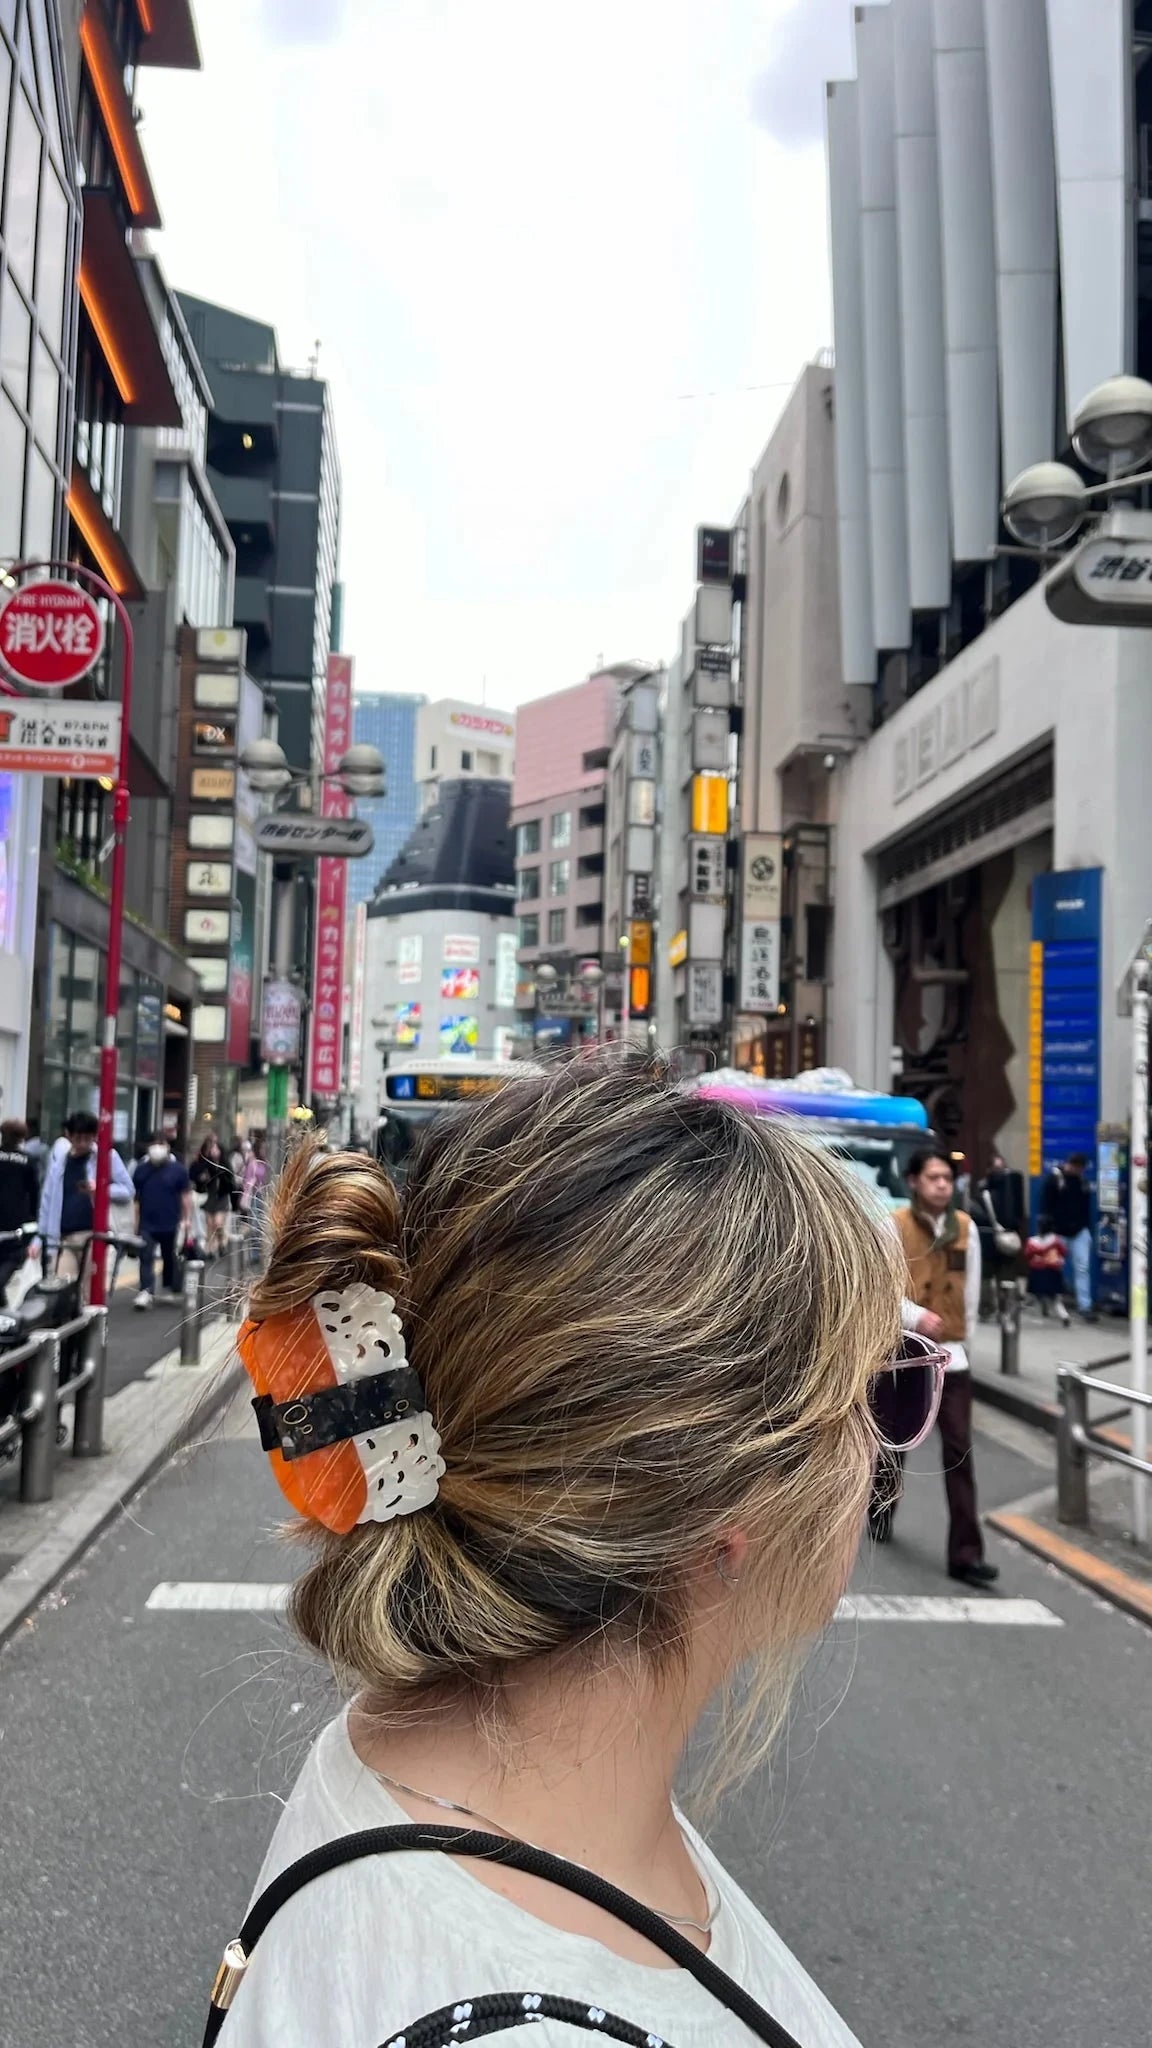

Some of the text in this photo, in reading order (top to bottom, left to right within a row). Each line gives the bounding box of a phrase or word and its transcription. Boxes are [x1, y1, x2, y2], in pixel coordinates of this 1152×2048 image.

[1089, 555, 1152, 581] 渋谷
[15, 594, 87, 608] FIRE HYDRANT
[5, 612, 95, 654] 消火栓
[319, 925, 340, 998] カラオケ
